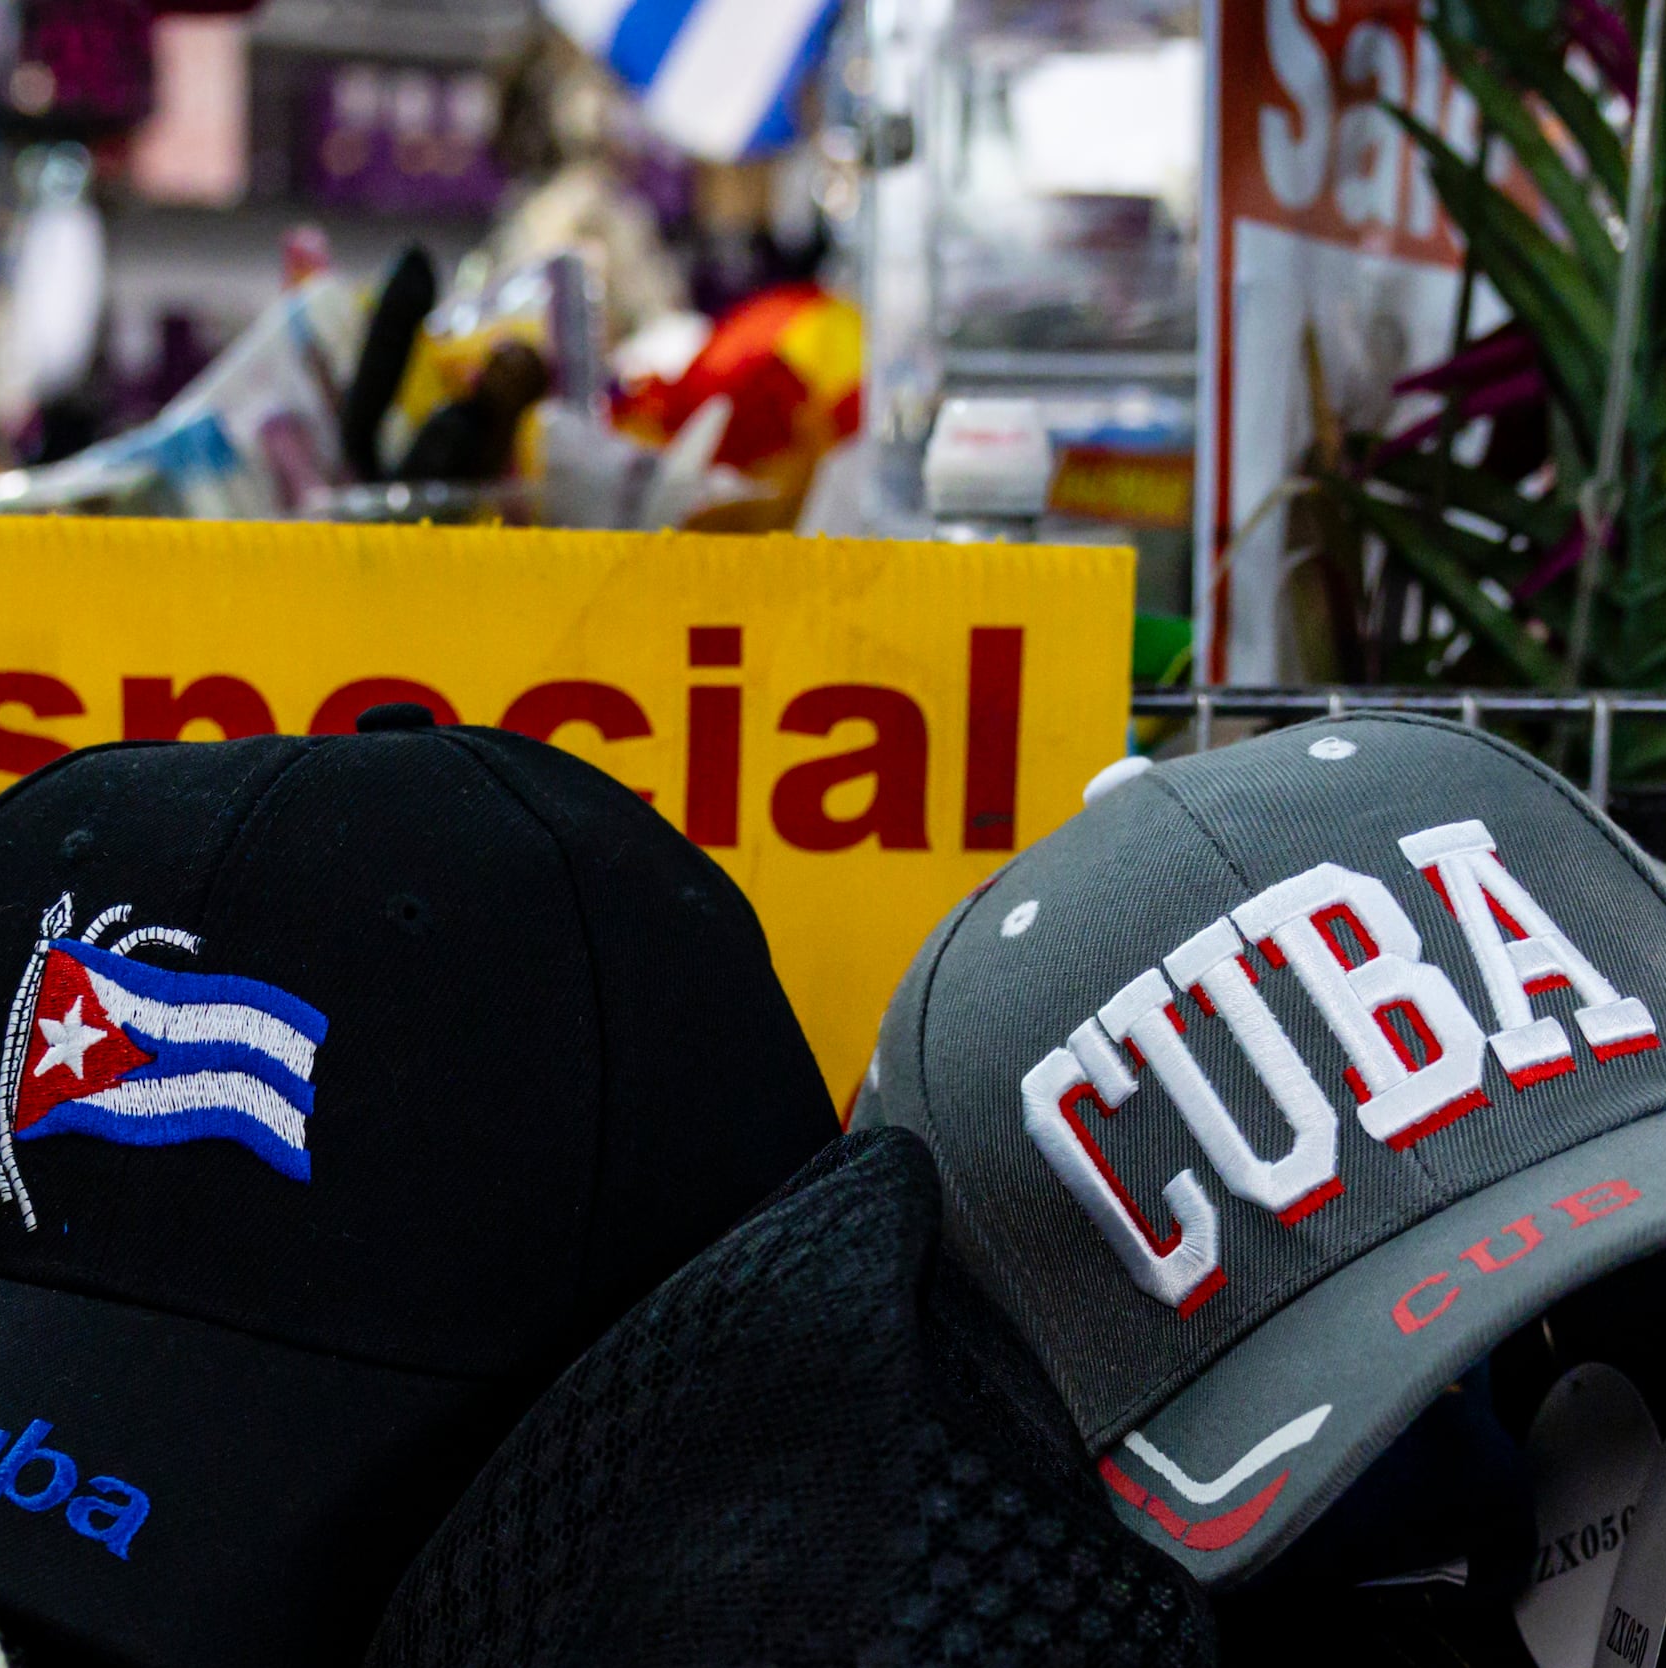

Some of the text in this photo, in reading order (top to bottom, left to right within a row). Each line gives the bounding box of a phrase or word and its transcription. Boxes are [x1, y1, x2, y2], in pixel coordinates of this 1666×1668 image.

[1257, 0, 1513, 246] Sal
[1019, 818, 1662, 1321] CUBA
[1391, 1179, 1642, 1335] CUB
